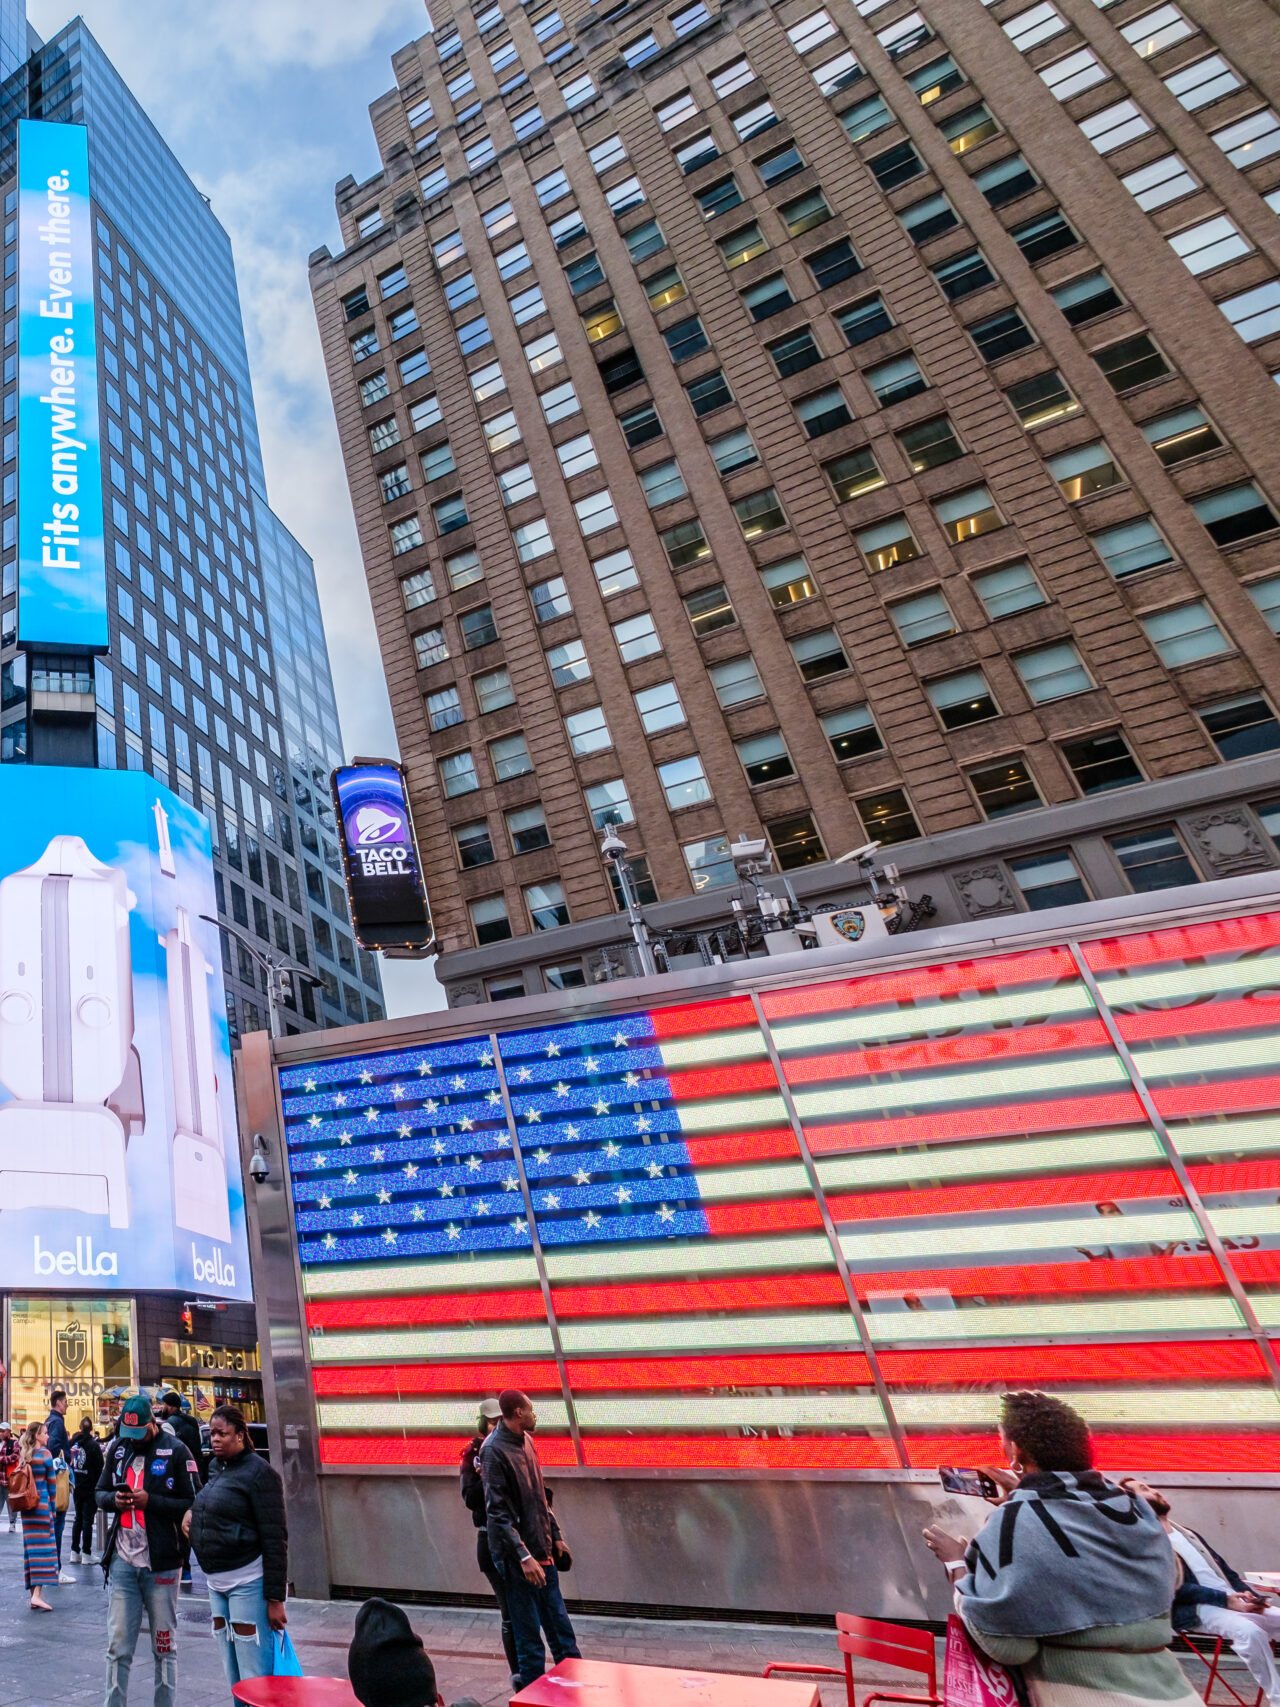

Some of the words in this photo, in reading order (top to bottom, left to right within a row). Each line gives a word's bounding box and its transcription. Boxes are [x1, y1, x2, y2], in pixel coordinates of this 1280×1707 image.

[38, 169, 71, 246] there.
[40, 252, 73, 319] Even
[40, 327, 86, 495] anywhere.
[41, 502, 80, 569] Fits
[356, 847, 407, 863] TACO
[362, 862, 412, 877] BELL
[33, 1235, 119, 1276] bella
[191, 1242, 235, 1288] bella
[197, 1349, 244, 1372] TOURO
[42, 1383, 104, 1397] TOURO
